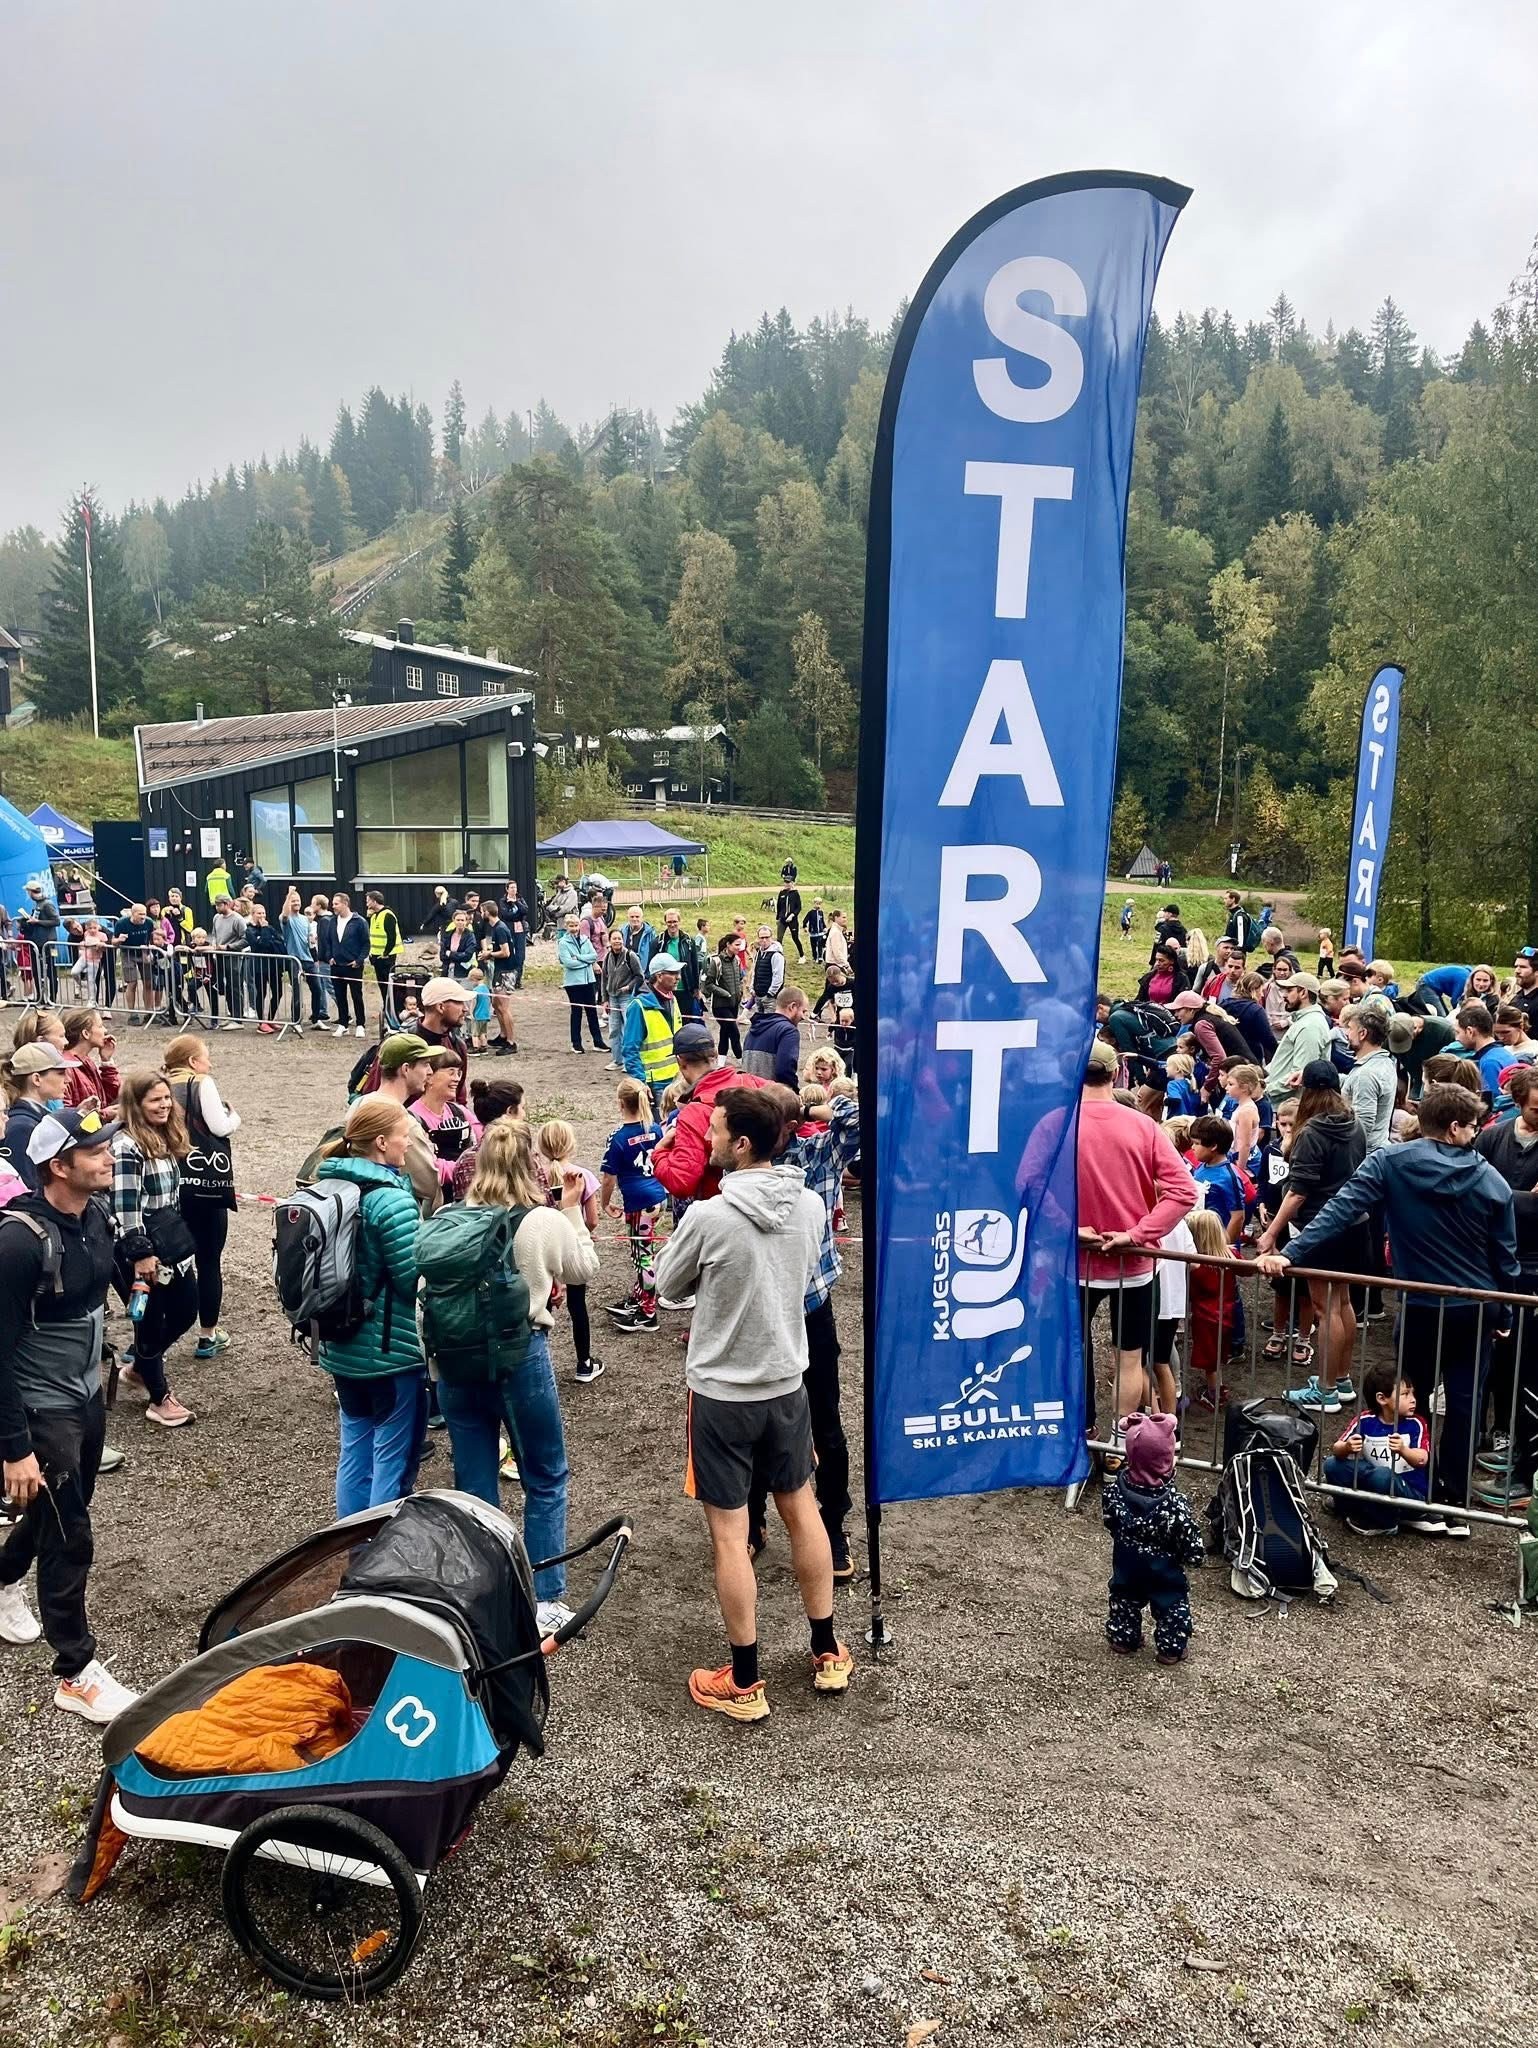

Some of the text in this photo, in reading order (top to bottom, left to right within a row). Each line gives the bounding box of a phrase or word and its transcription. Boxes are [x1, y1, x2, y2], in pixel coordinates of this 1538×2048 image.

[934, 255, 1087, 1154] START
[940, 1405, 1032, 1431] BULL
[912, 1424, 1059, 1449] SKI & KAJAKK AS
[734, 1693, 756, 1704] HOKA
